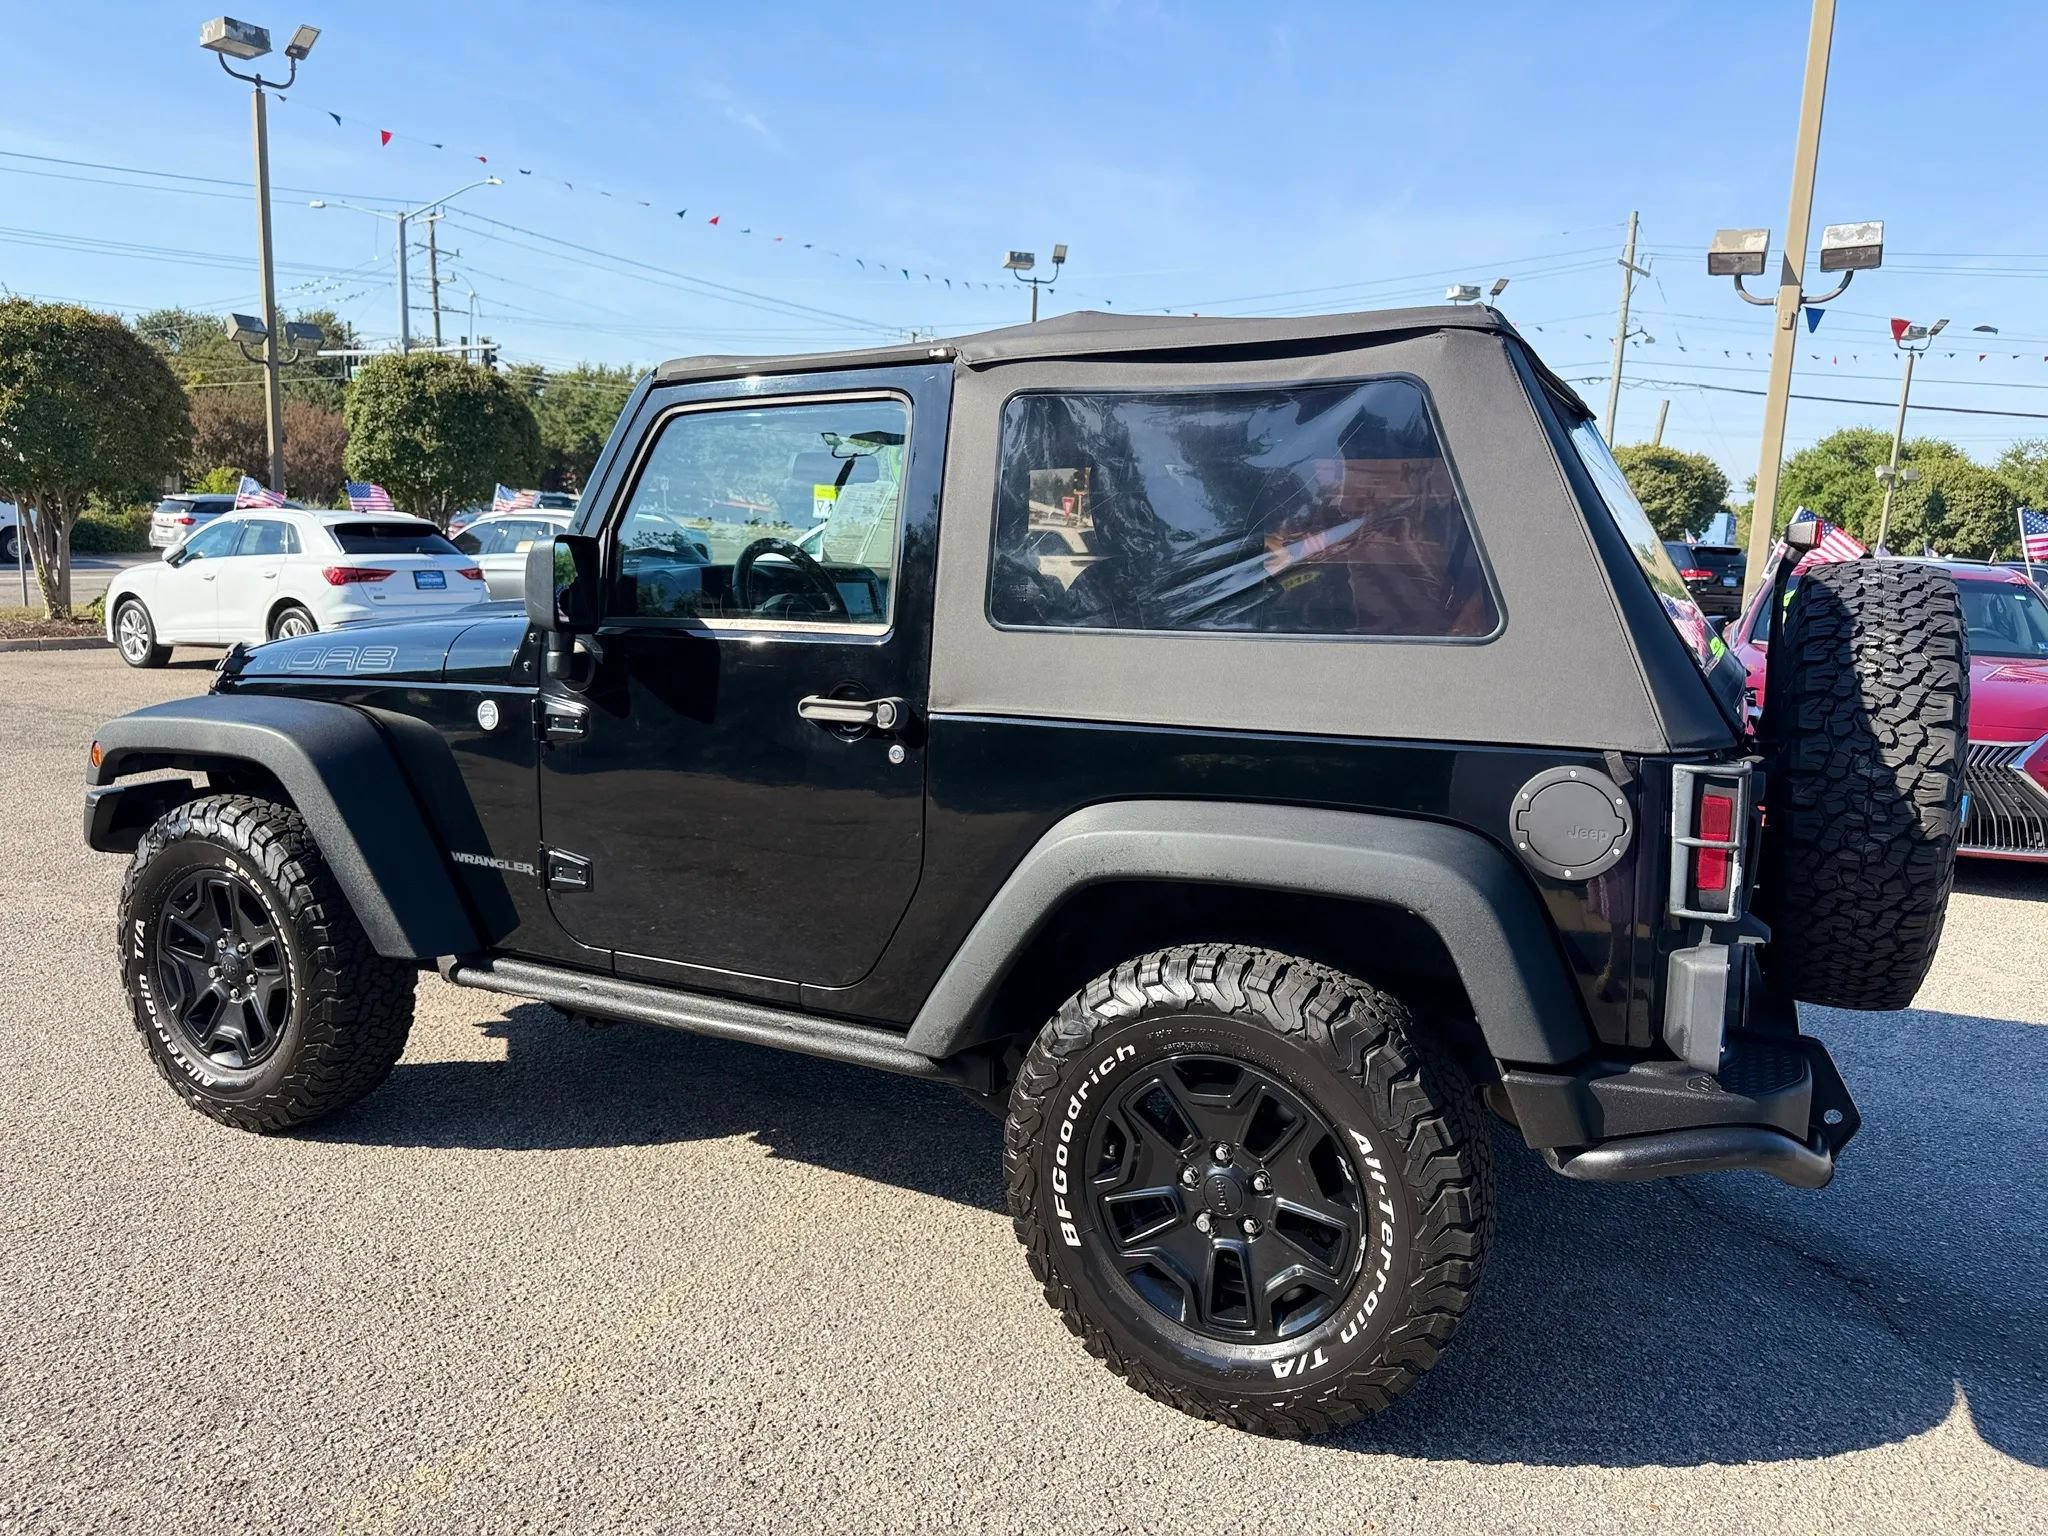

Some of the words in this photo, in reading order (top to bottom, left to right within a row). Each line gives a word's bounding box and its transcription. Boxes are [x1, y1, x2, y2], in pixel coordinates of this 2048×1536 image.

[1566, 824, 1609, 843] Jeep
[450, 851, 535, 876] WRANGLER
[134, 919, 146, 960] T/A
[139, 974, 217, 1087] All-Terrain
[1052, 1044, 1136, 1247] BFGoodrich
[1340, 1128, 1395, 1344] All-Terrain
[1271, 1347, 1329, 1378] T/A
